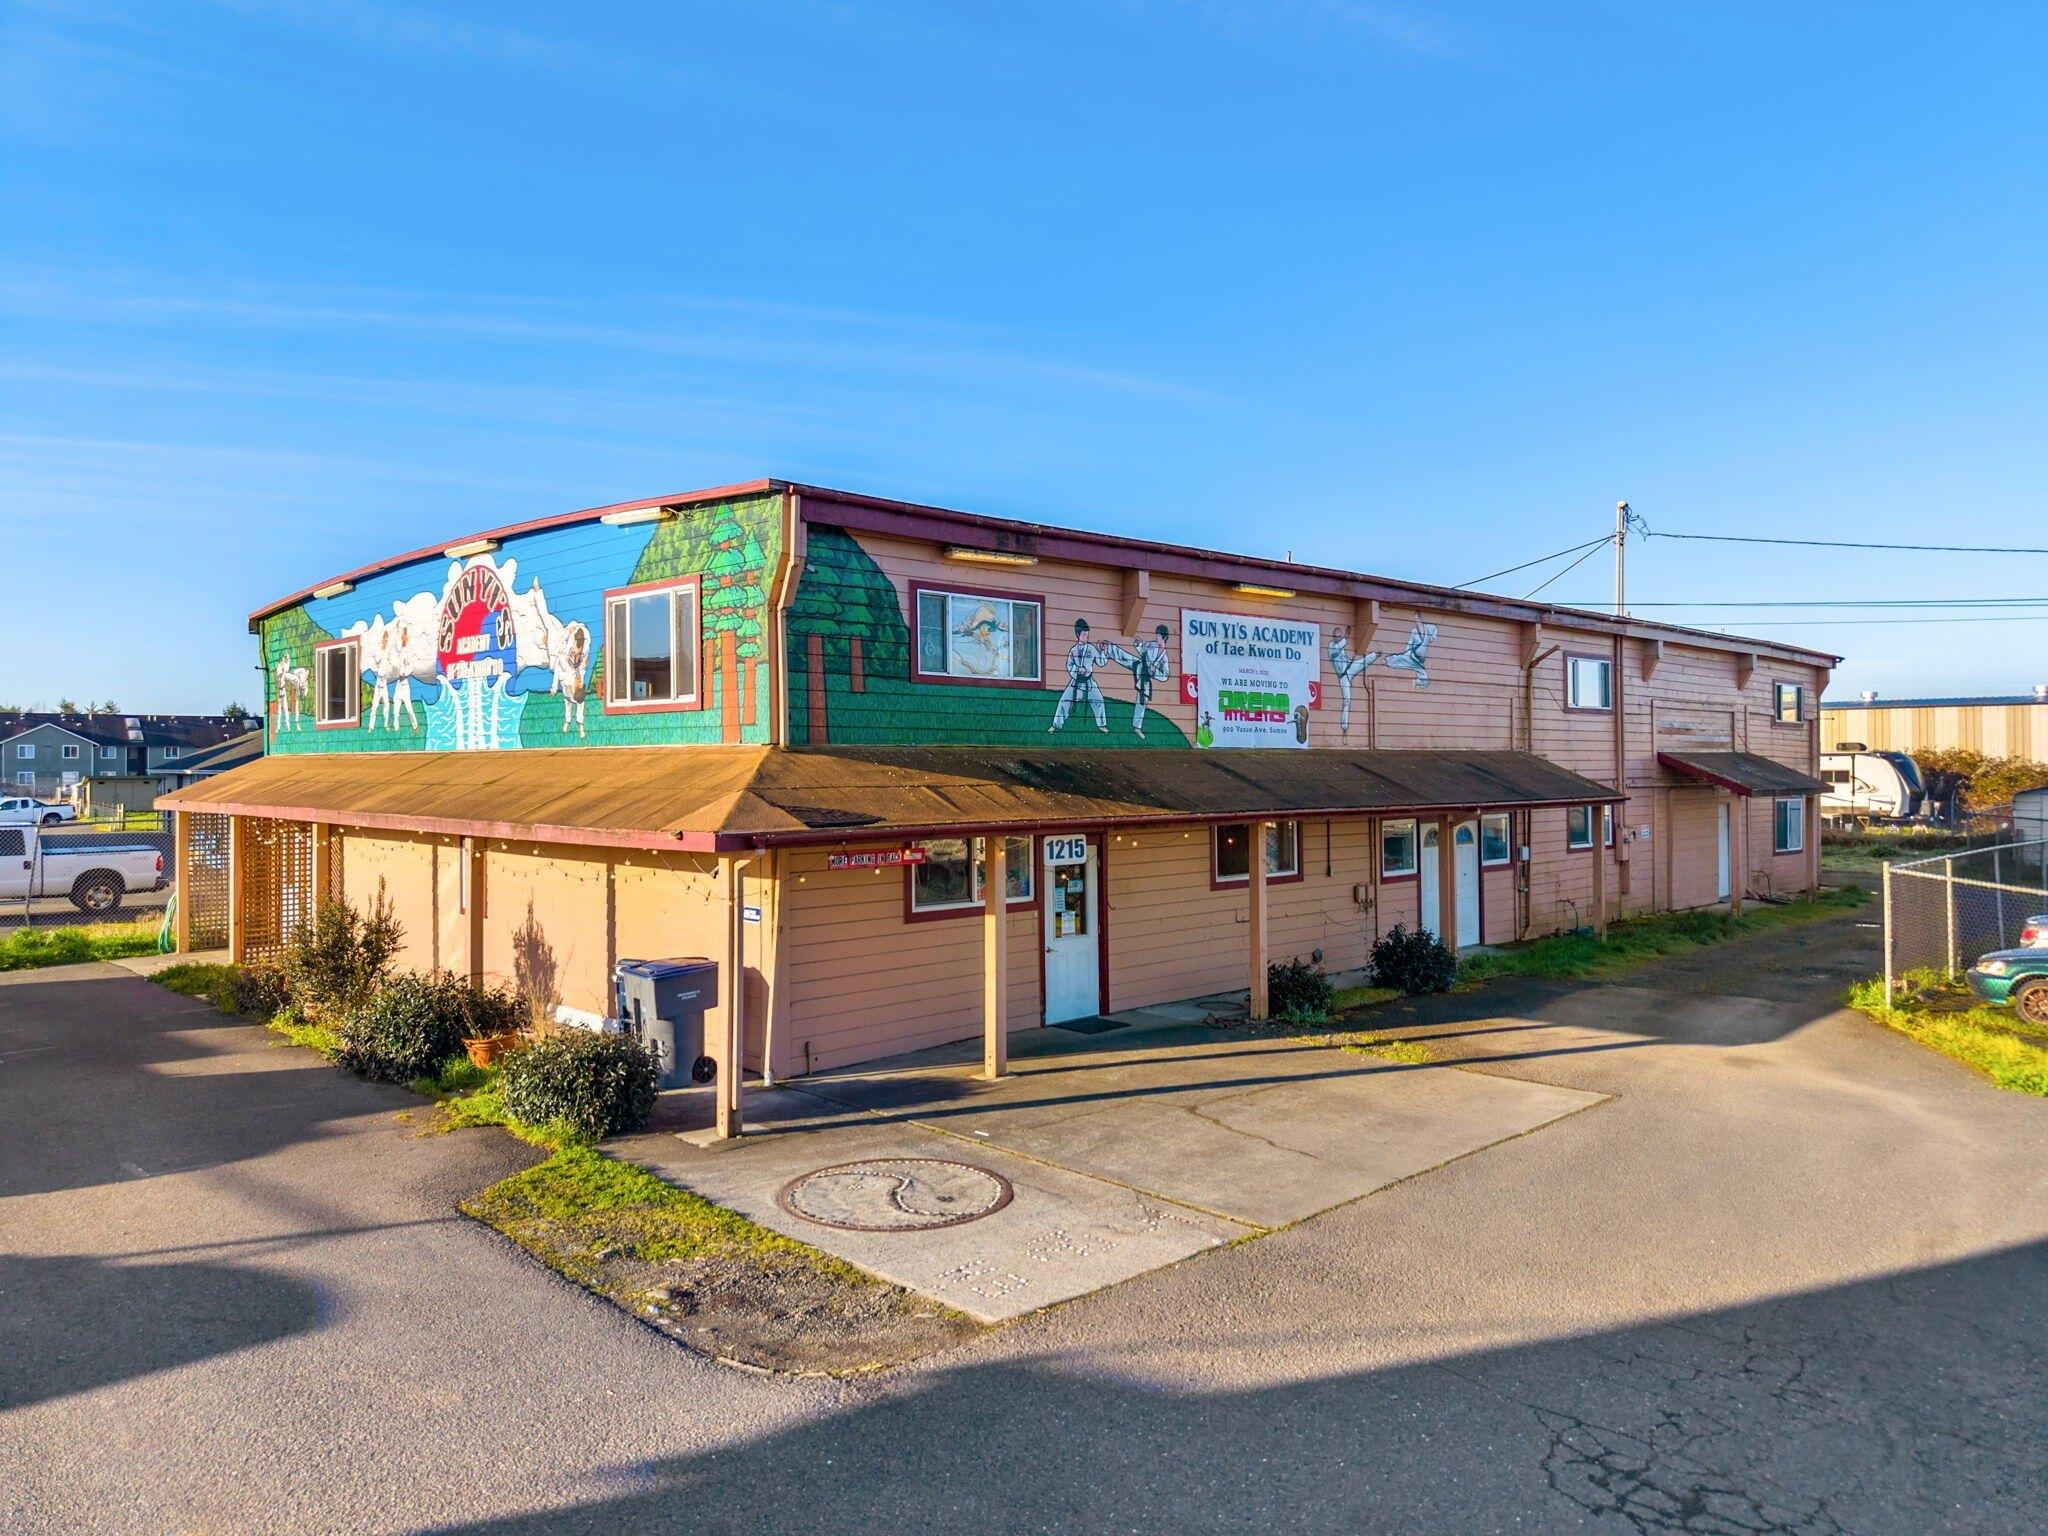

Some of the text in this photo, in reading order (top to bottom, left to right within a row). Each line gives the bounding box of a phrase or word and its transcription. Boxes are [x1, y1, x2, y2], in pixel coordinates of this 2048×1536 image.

[438, 567, 514, 652] SUN YI'S
[1189, 619, 1315, 646] SUN YI'S ACADEMY
[1205, 641, 1301, 660] of Tae Kwon Do
[1221, 677, 1288, 689] WE ARE MOVING TO
[1218, 690, 1290, 714] DREAM
[850, 852, 876, 866] PARKING
[1046, 838, 1085, 860] 1215
